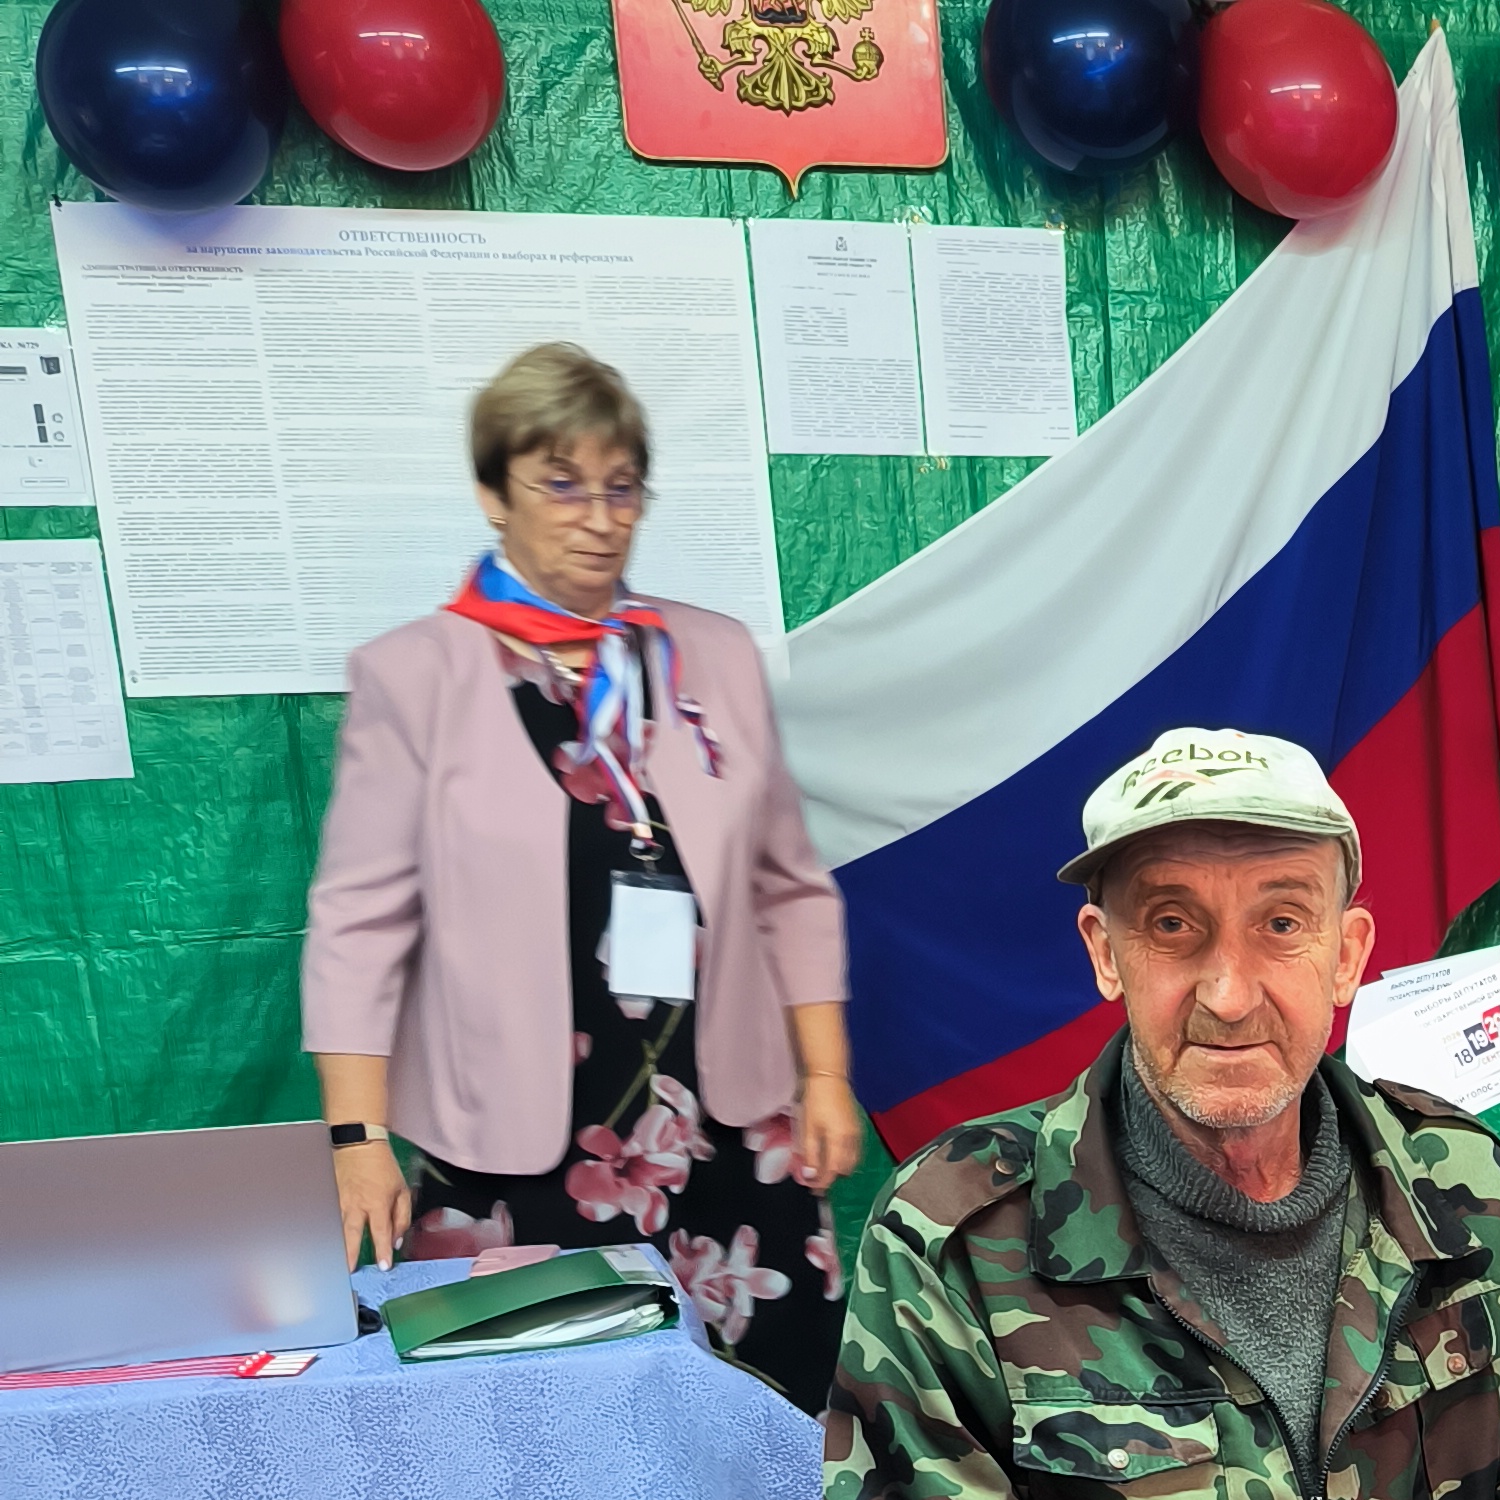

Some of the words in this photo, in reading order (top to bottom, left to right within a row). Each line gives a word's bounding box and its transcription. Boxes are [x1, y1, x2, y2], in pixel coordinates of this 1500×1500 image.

[338, 229, 487, 244] ОТВЕТСТВЕННОСТЬ
[200, 246, 262, 257] нарушение
[265, 247, 362, 257] законодательства
[364, 246, 428, 258] Российской
[430, 248, 490, 261] Федерации
[501, 251, 547, 262] выборах
[559, 252, 634, 264] референдумах
[1390, 979, 1415, 990] ВЫБОРЫ
[1416, 968, 1451, 984] ДЕПУТАТОВ
[1414, 996, 1452, 1017] ВЫБОРЫ
[1453, 973, 1498, 999] ДЕПУТАТОВ
[1468, 1029, 1489, 1050] 19
[1454, 1048, 1474, 1067] 18
[1466, 1082, 1494, 1100] ГОЛОС
